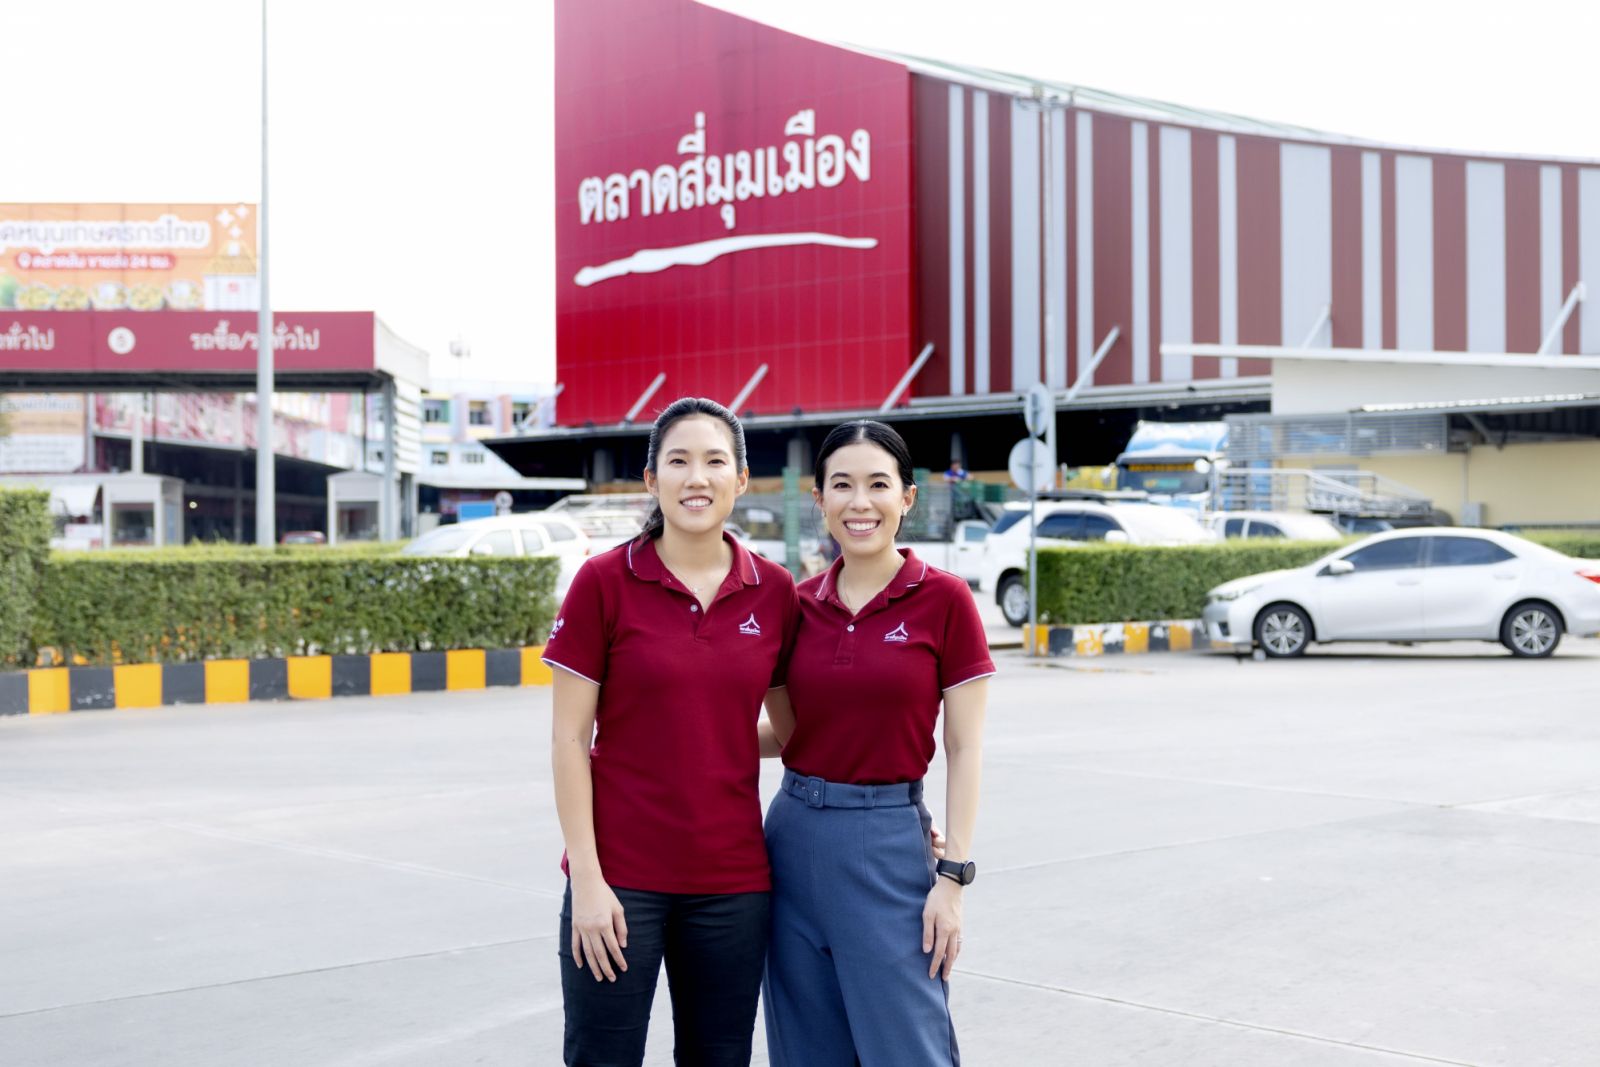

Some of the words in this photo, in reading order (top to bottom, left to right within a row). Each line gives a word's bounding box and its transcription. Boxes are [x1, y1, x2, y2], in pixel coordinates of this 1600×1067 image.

[578, 108, 871, 230] ตลาดสี่มุมเมือง
